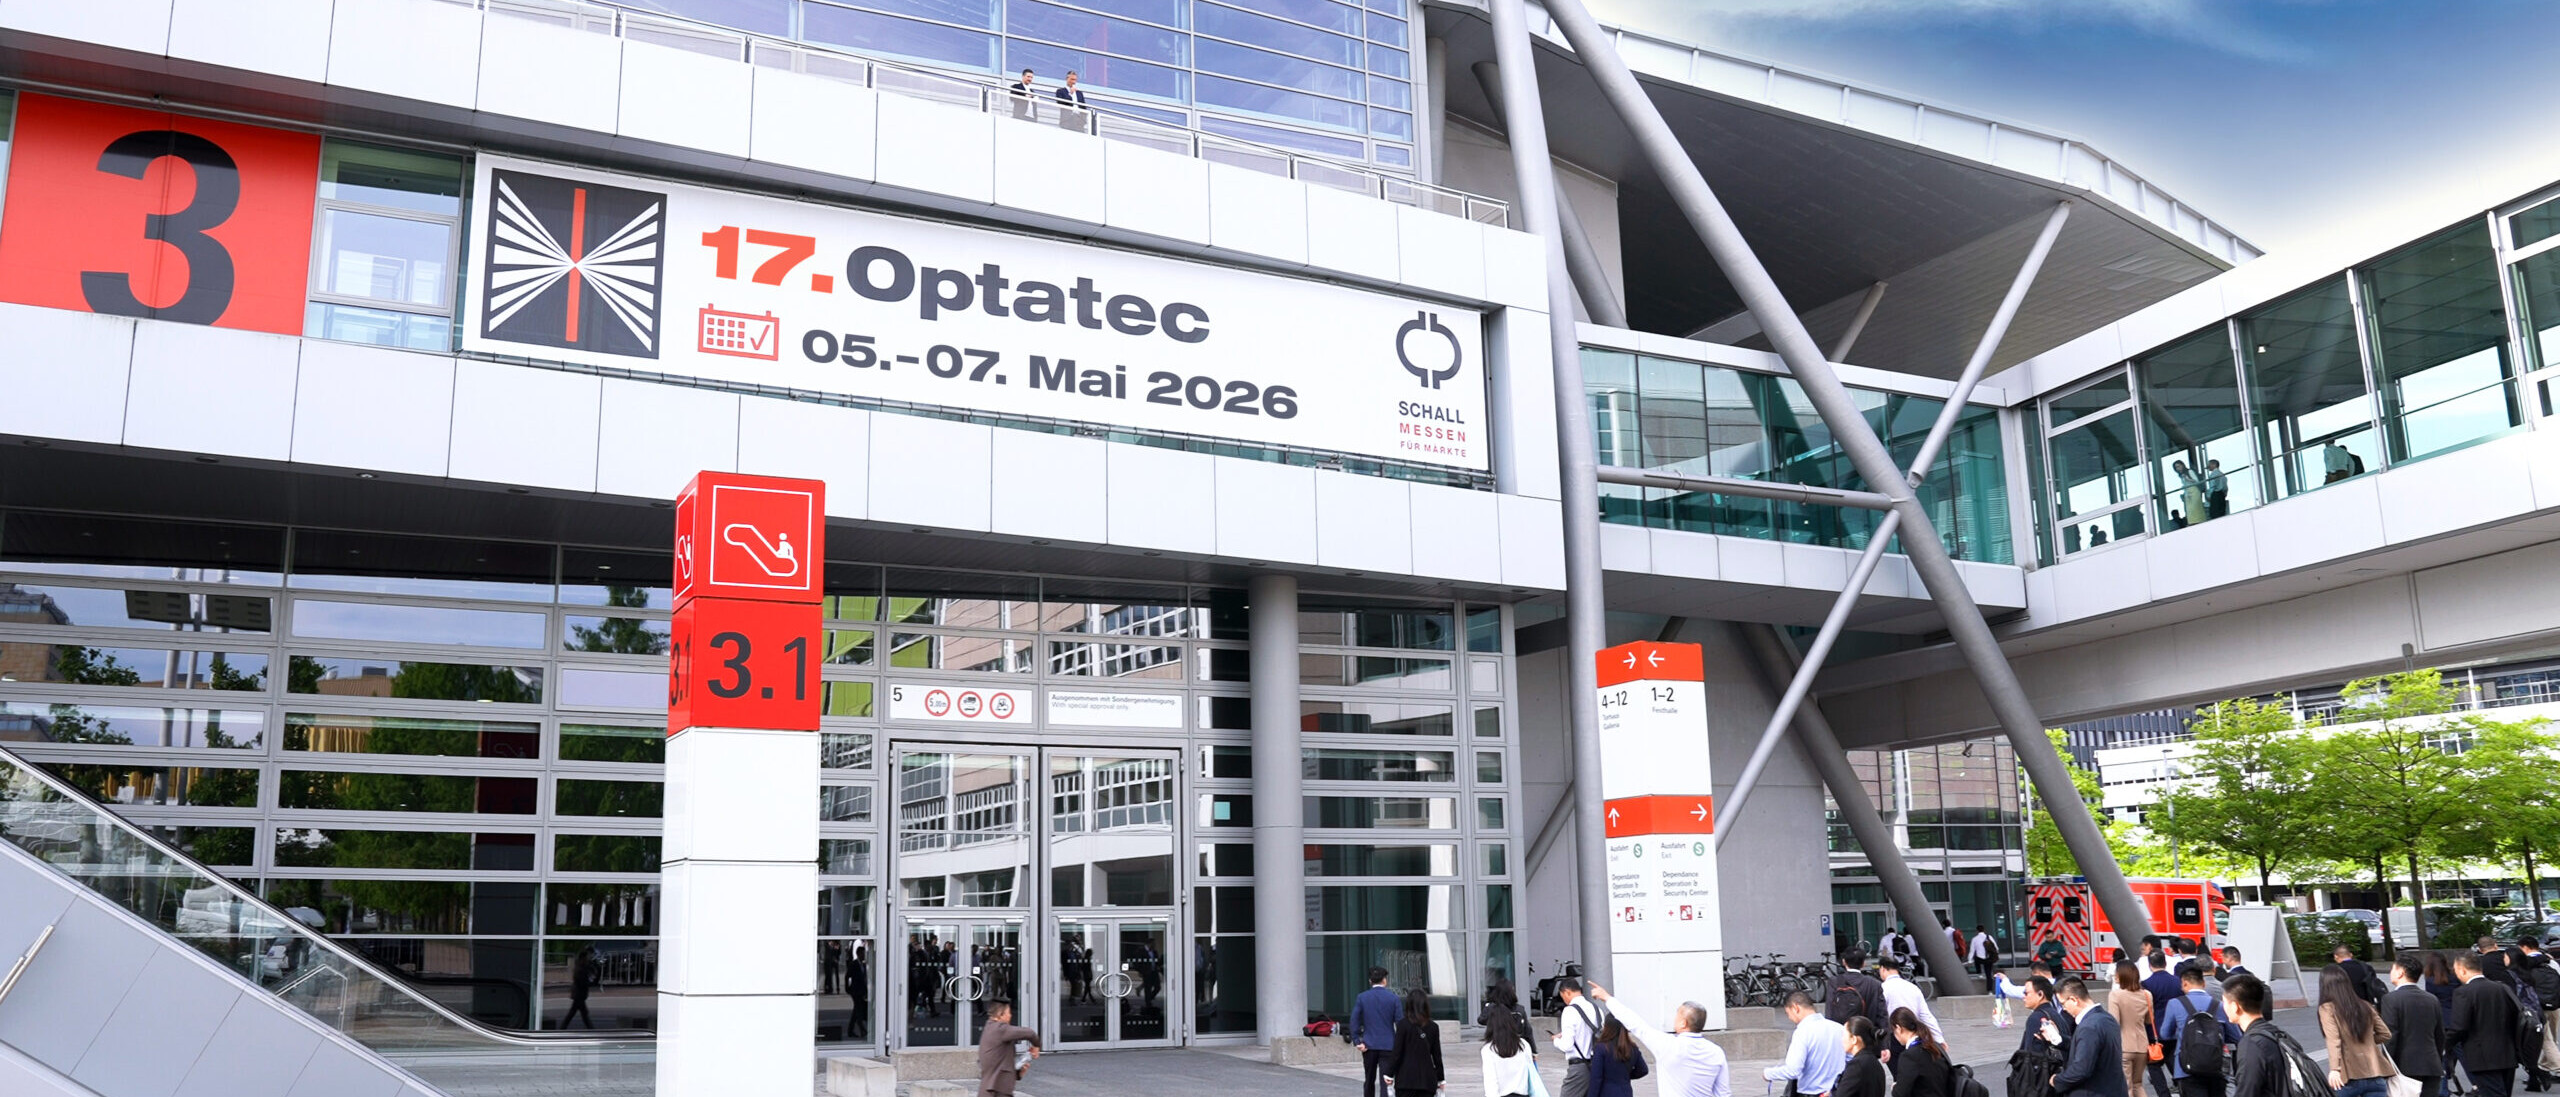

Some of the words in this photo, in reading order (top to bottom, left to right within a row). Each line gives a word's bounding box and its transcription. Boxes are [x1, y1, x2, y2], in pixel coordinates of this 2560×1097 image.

[80, 130, 241, 326] 3
[701, 224, 834, 294] 17.
[845, 244, 1211, 344] Optatec
[1028, 354, 1128, 400] Mai
[1146, 368, 1299, 422] 2026
[1398, 400, 1465, 425] SCHALL
[1399, 422, 1466, 443] MESSEN
[1400, 440, 1421, 451] FÜR
[670, 633, 691, 707] 3.1
[707, 631, 807, 701] 3.1
[893, 687, 903, 702] 5
[1052, 694, 1099, 703] Ausgenommen
[1100, 695, 1111, 703] mit
[1068, 702, 1089, 710] special
[1090, 702, 1115, 710] approval
[1662, 870, 1699, 879] Dependance
[1663, 880, 1692, 888] Operation
[1663, 889, 1688, 898] Security
[1689, 888, 1708, 896] Center
[1821, 915, 1829, 928] P
